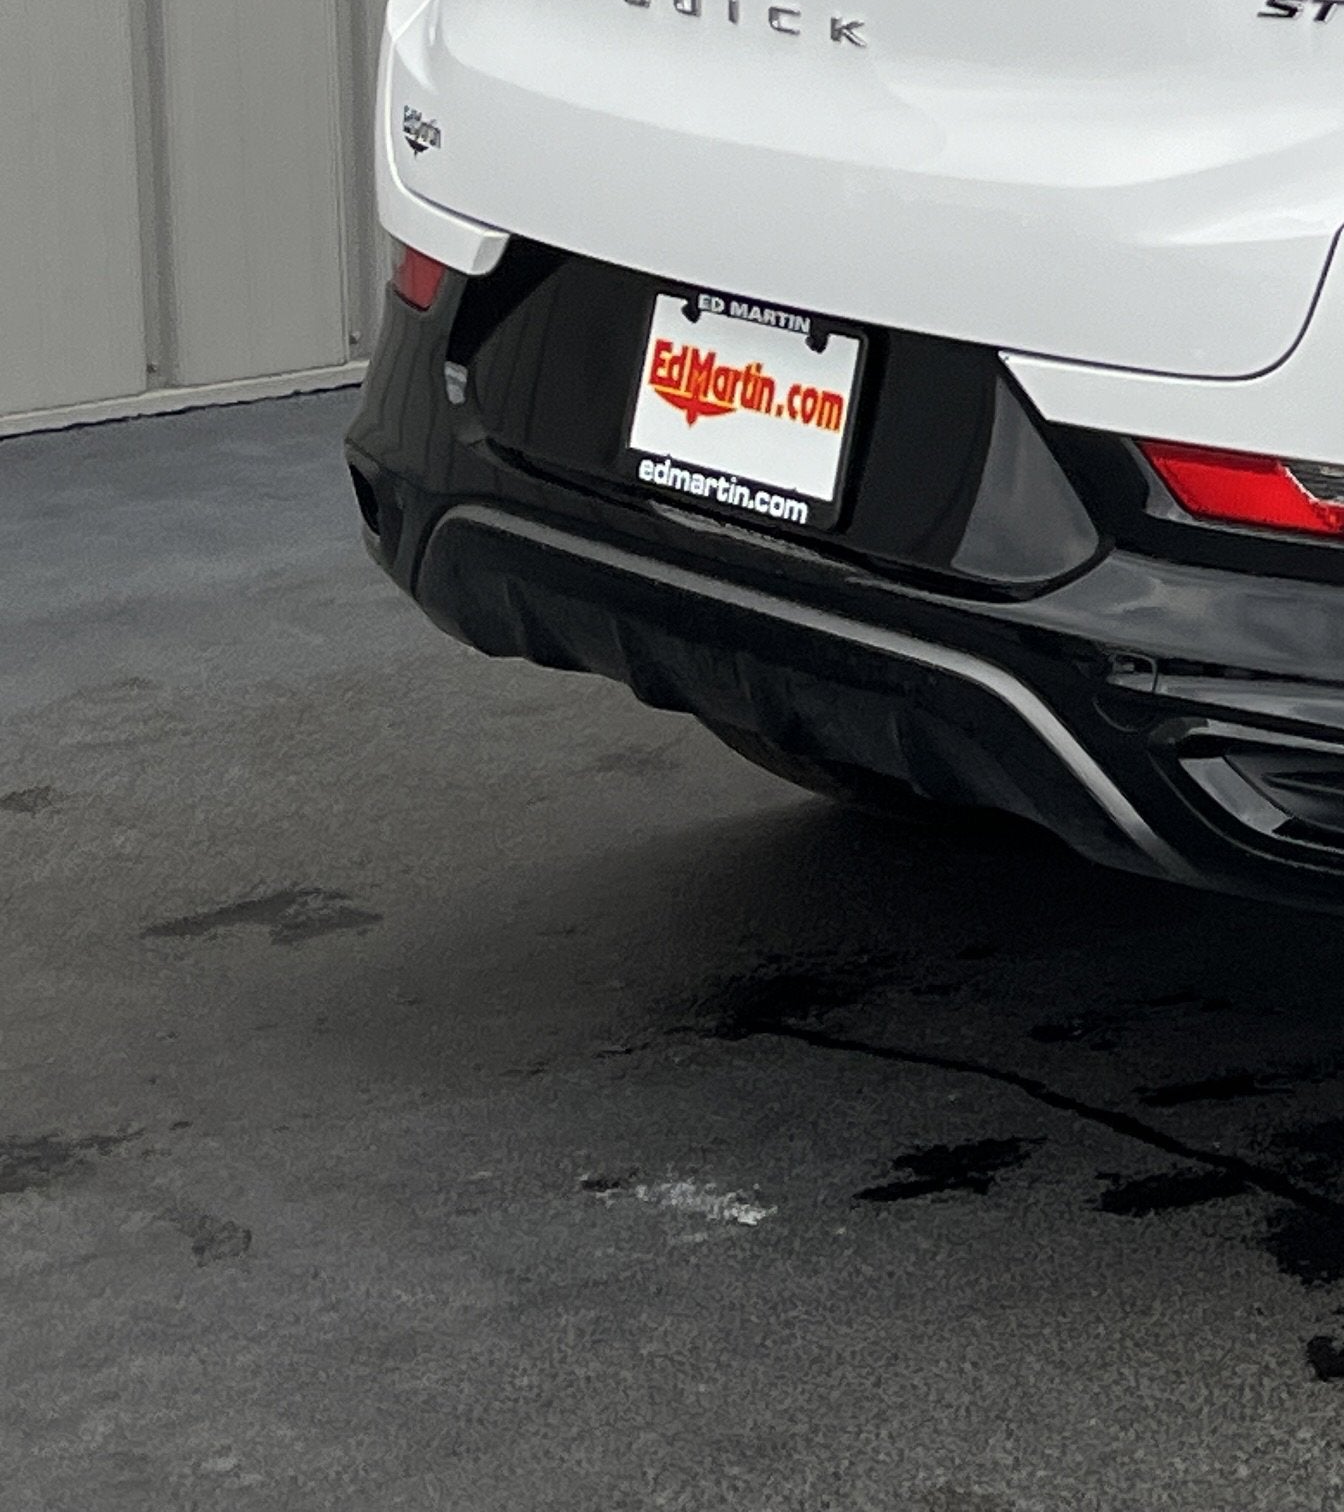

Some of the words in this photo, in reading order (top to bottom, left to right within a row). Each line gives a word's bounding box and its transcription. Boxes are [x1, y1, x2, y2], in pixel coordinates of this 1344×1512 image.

[698, 293, 725, 313] ED
[730, 301, 811, 334] MARTIN
[648, 339, 844, 431] EdMartin.com
[638, 457, 808, 524] edmartin.com
